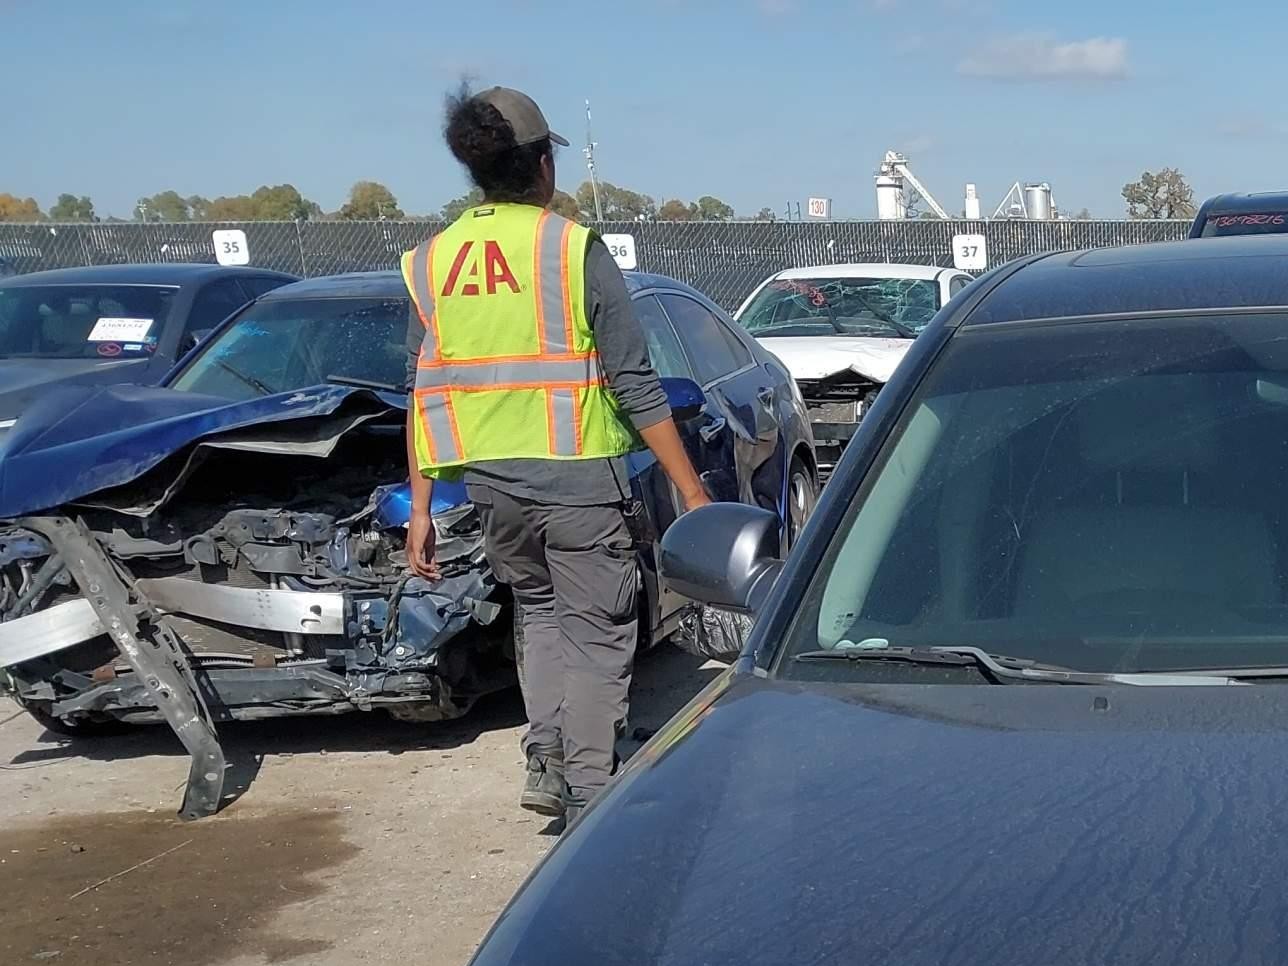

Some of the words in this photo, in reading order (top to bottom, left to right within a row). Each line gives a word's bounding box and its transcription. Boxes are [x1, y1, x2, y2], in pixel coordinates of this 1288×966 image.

[811, 202, 825, 215] 130
[223, 241, 240, 254] 35
[610, 245, 627, 257] 36
[961, 245, 978, 258] 37
